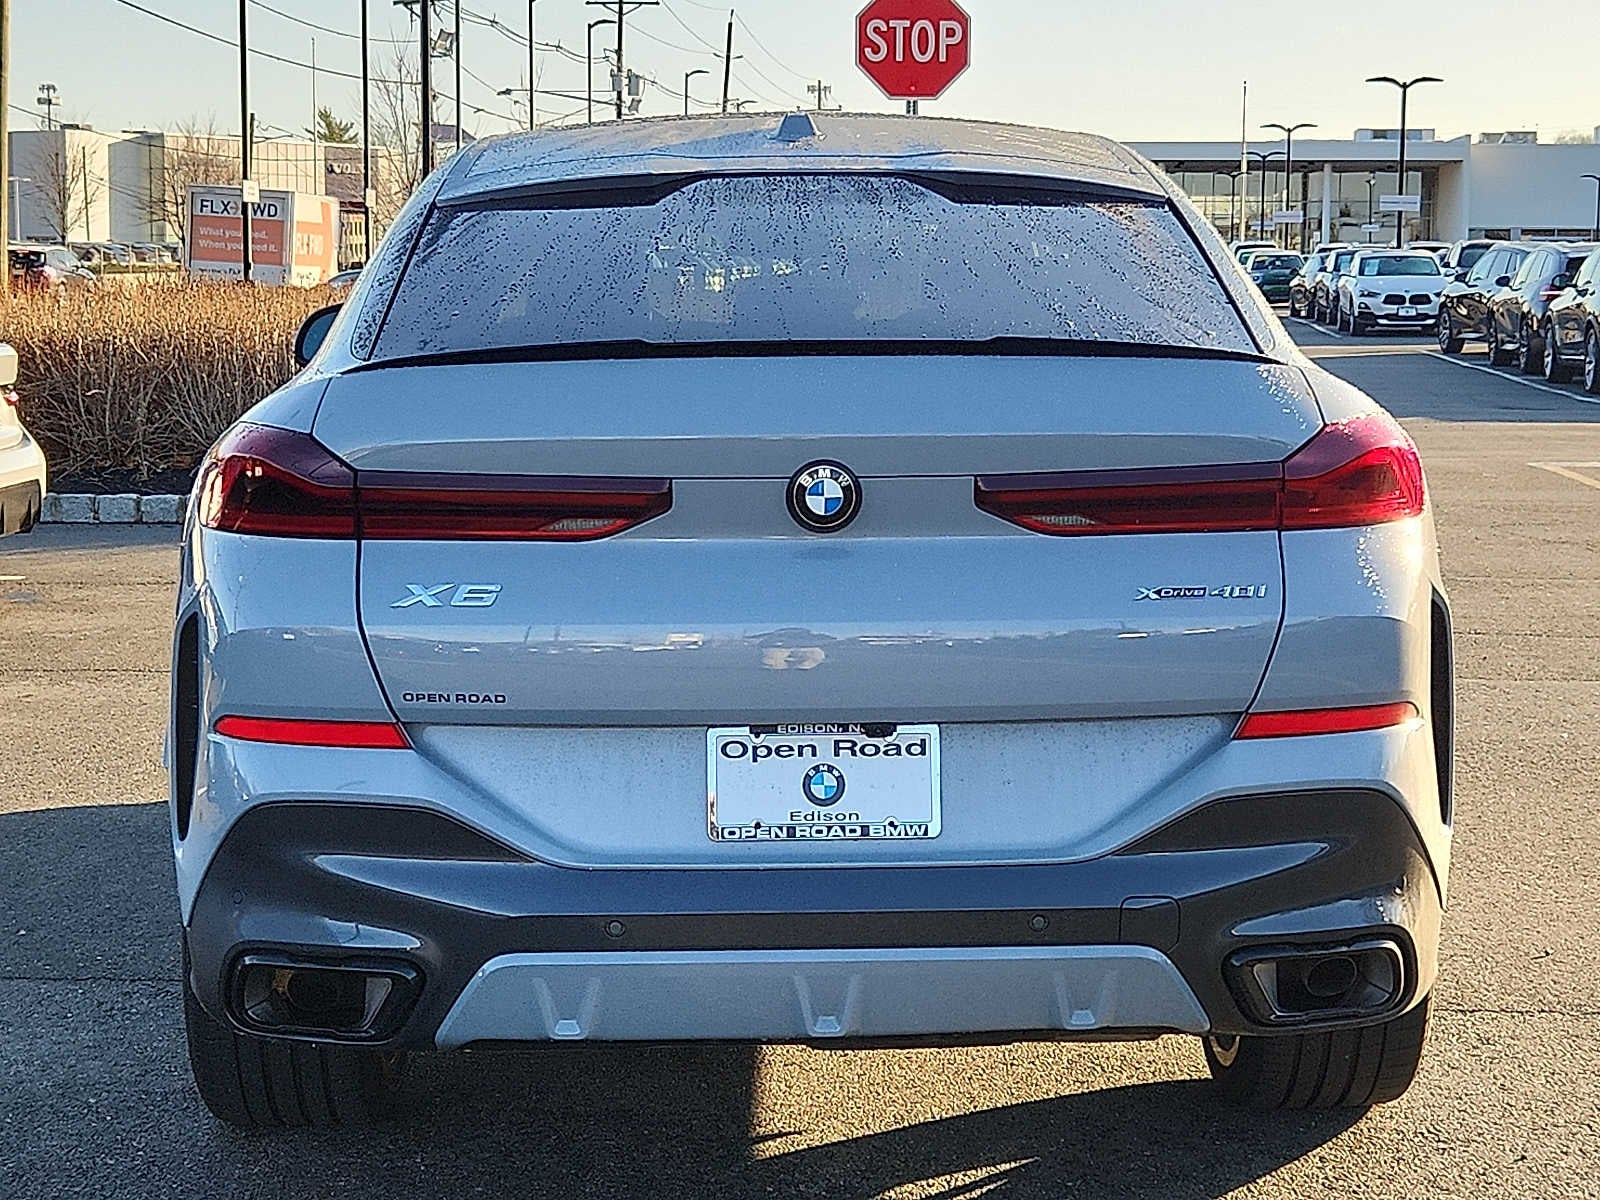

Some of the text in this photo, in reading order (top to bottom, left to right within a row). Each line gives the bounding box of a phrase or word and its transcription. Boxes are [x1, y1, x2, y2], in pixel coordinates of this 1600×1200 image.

[864, 19, 963, 62] STOP
[199, 198, 278, 218] FLX WD
[199, 226, 224, 237] What
[225, 228, 242, 239] you
[198, 239, 226, 250] When
[800, 468, 850, 487] BMW
[389, 582, 503, 608] X6
[402, 692, 507, 704] OPEN ROAD
[777, 724, 867, 734] EDISON, N
[720, 738, 928, 763] Open Road
[808, 765, 841, 777] BMW
[789, 810, 860, 822] Edison
[723, 824, 927, 839] OPEN ROAD BMW
